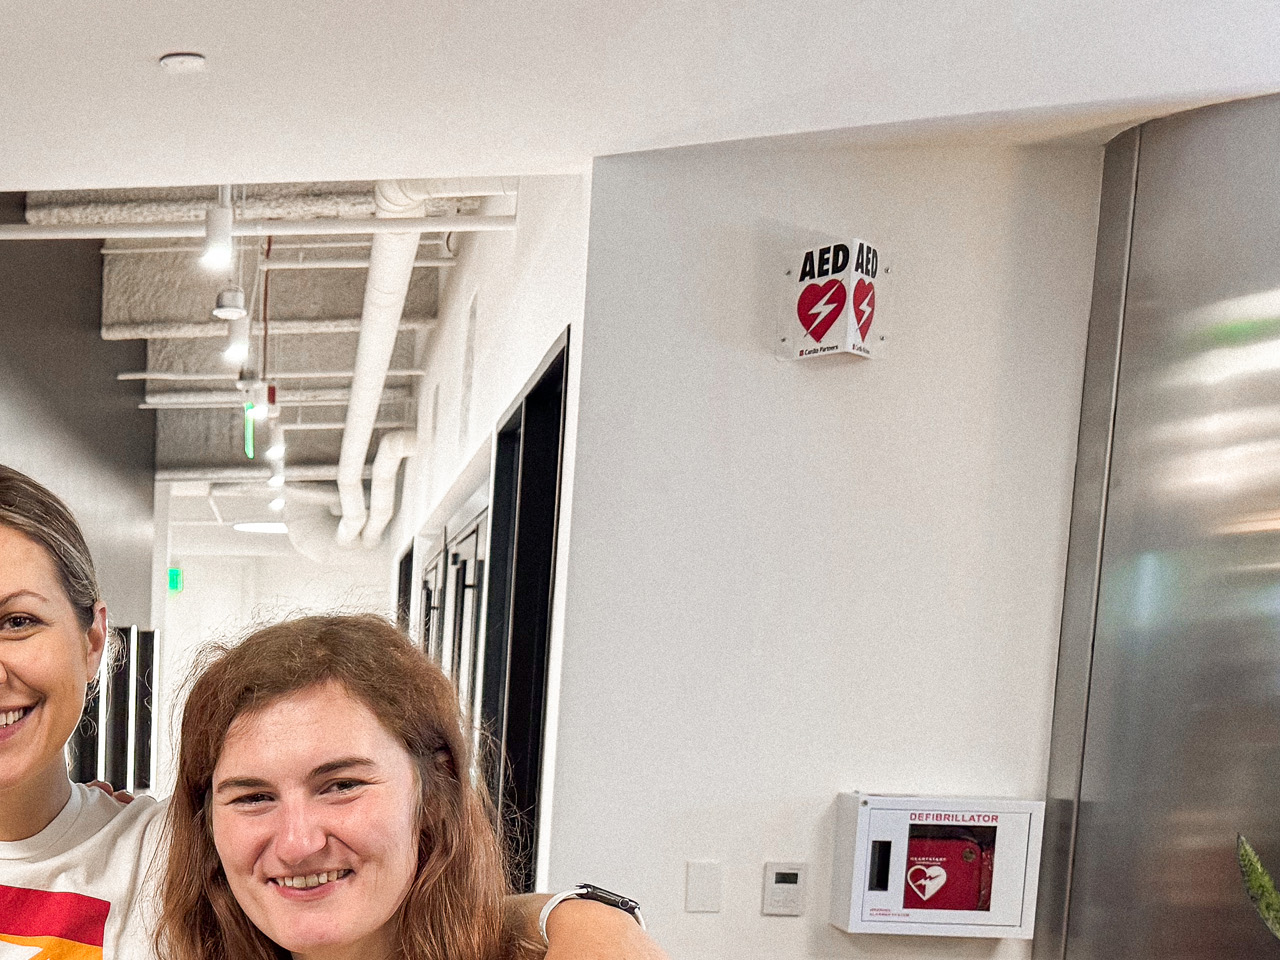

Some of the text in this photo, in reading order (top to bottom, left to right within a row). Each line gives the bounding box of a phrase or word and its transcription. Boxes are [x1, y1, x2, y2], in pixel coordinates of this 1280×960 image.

[799, 244, 850, 282] AED
[854, 242, 878, 279] AED
[909, 812, 999, 823] DEFIBRILLATOR
